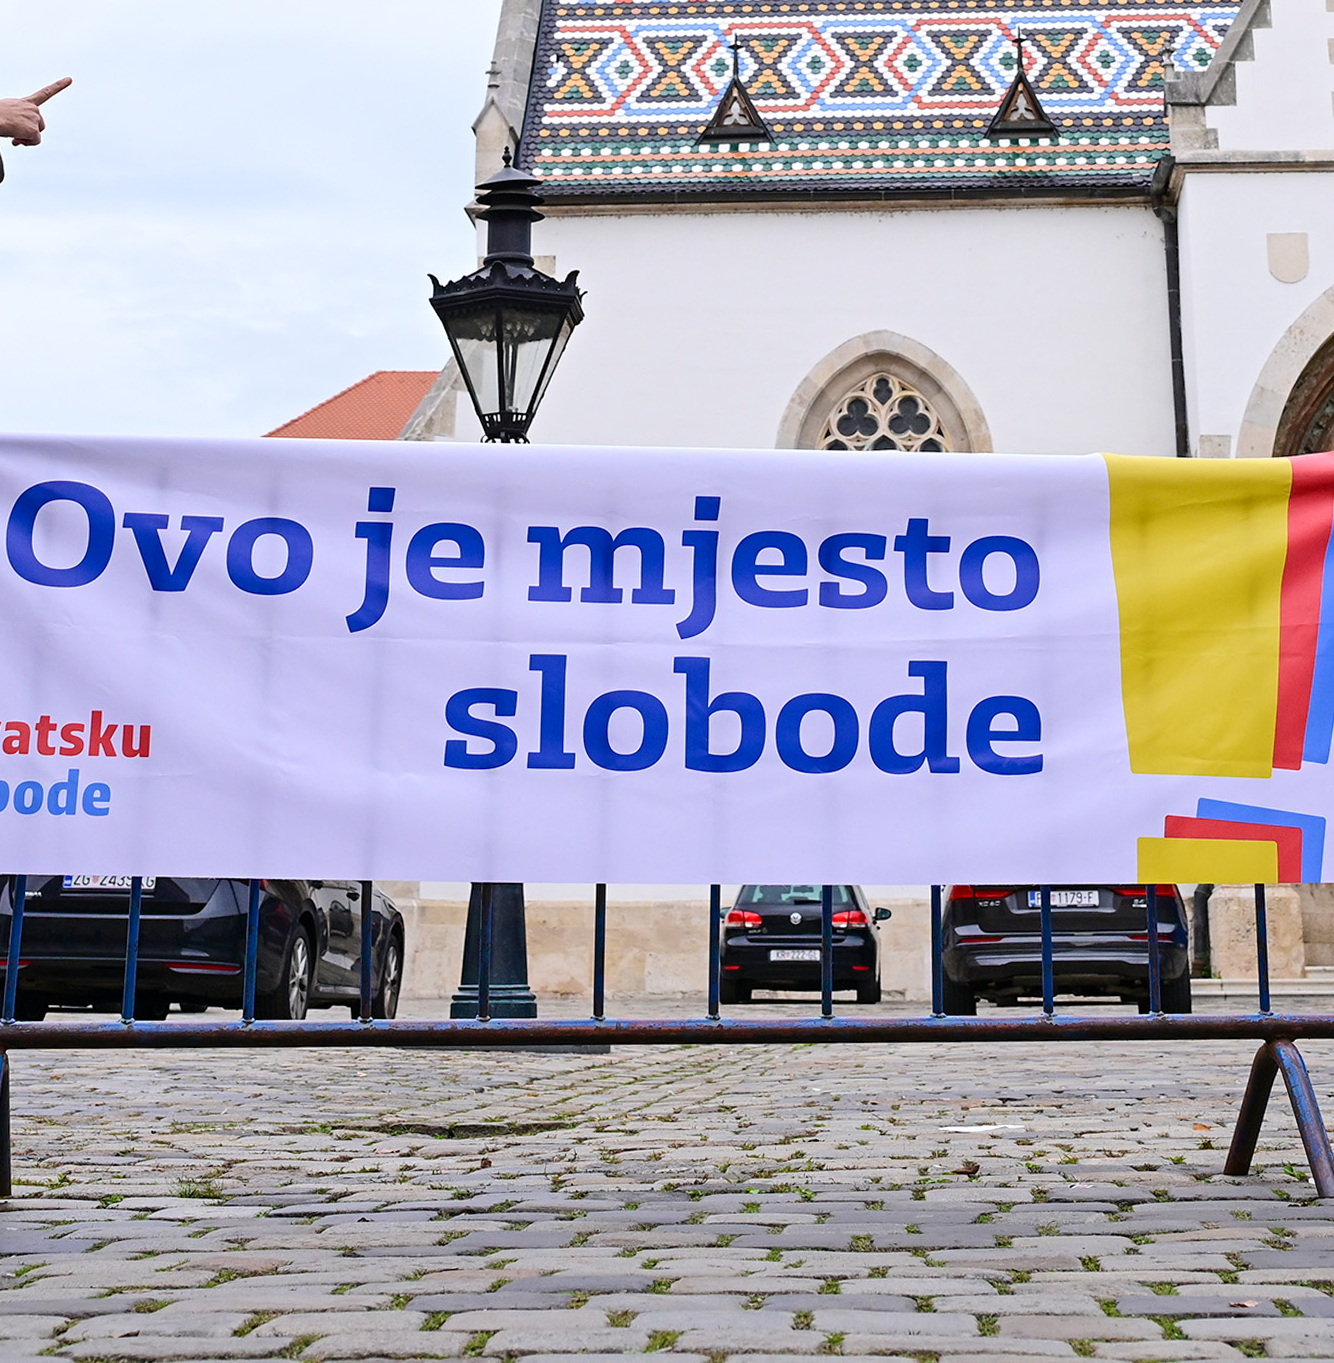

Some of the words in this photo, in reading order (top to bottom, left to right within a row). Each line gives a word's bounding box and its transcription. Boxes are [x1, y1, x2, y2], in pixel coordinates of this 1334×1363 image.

[6, 481, 313, 595] Ovo
[346, 487, 485, 633] je
[527, 496, 1040, 639] mjesto
[444, 654, 1043, 775] slobode
